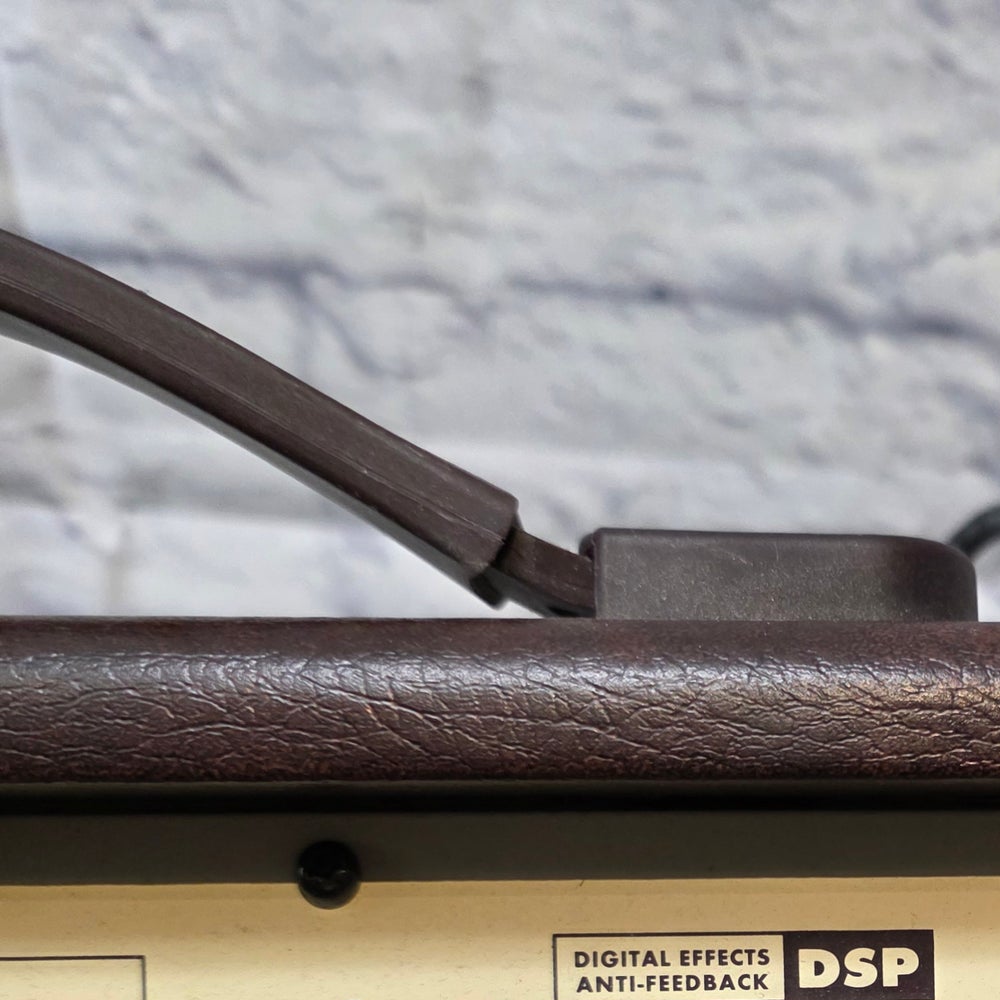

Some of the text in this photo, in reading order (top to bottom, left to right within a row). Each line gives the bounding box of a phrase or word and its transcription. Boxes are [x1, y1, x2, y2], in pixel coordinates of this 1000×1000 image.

[574, 948, 770, 968] DIGITAL EFFECTS
[798, 947, 920, 989] DSP
[576, 973, 769, 993] ANTI-FEEDBACK
